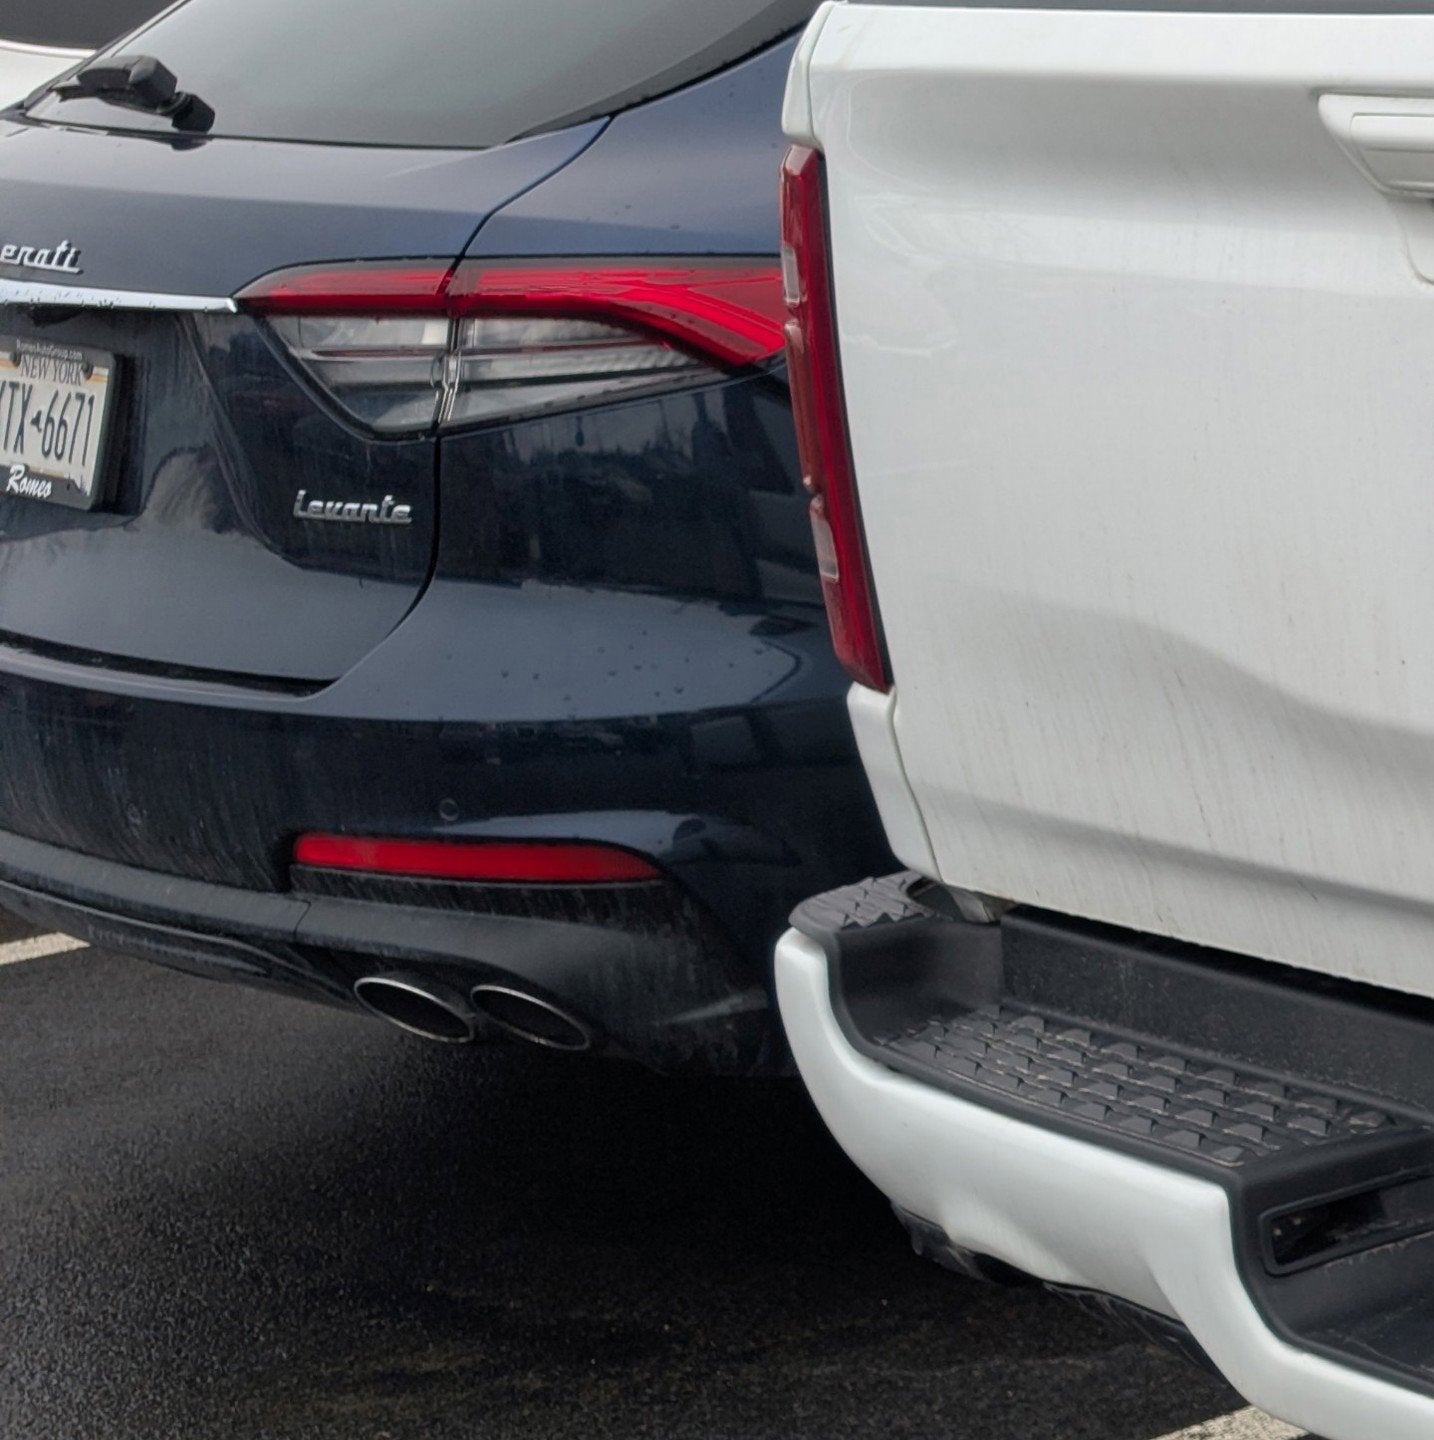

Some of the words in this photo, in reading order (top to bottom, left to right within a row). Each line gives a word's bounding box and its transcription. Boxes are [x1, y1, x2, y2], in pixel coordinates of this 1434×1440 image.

[21, 355, 53, 380] NEW
[53, 360, 83, 387] YORK
[6, 464, 52, 498] Romeo
[293, 489, 412, 523] Levante
